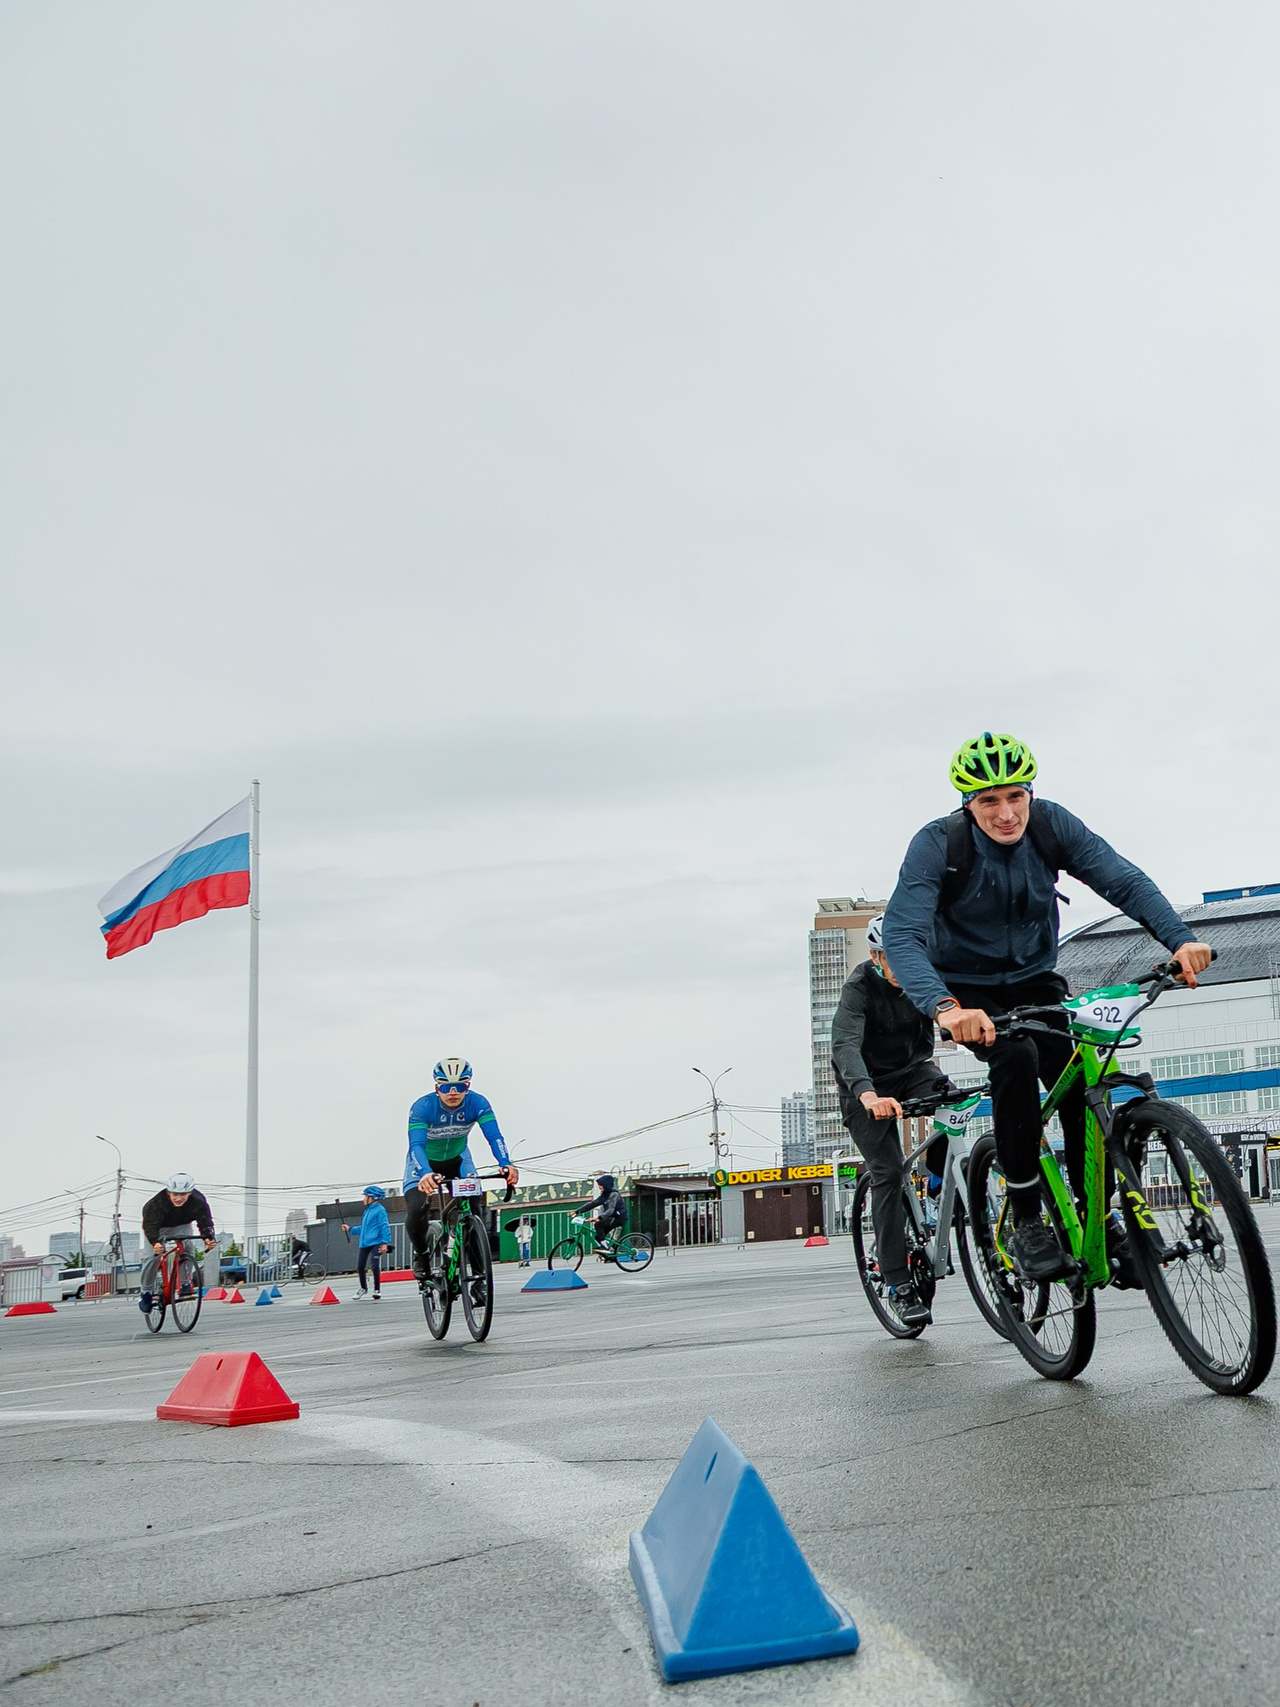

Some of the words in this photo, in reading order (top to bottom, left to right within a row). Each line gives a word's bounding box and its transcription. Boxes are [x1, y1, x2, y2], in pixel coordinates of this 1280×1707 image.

[1092, 1006, 1123, 1024] 922
[728, 1169, 782, 1185] DONER
[458, 1183, 476, 1192] 39
